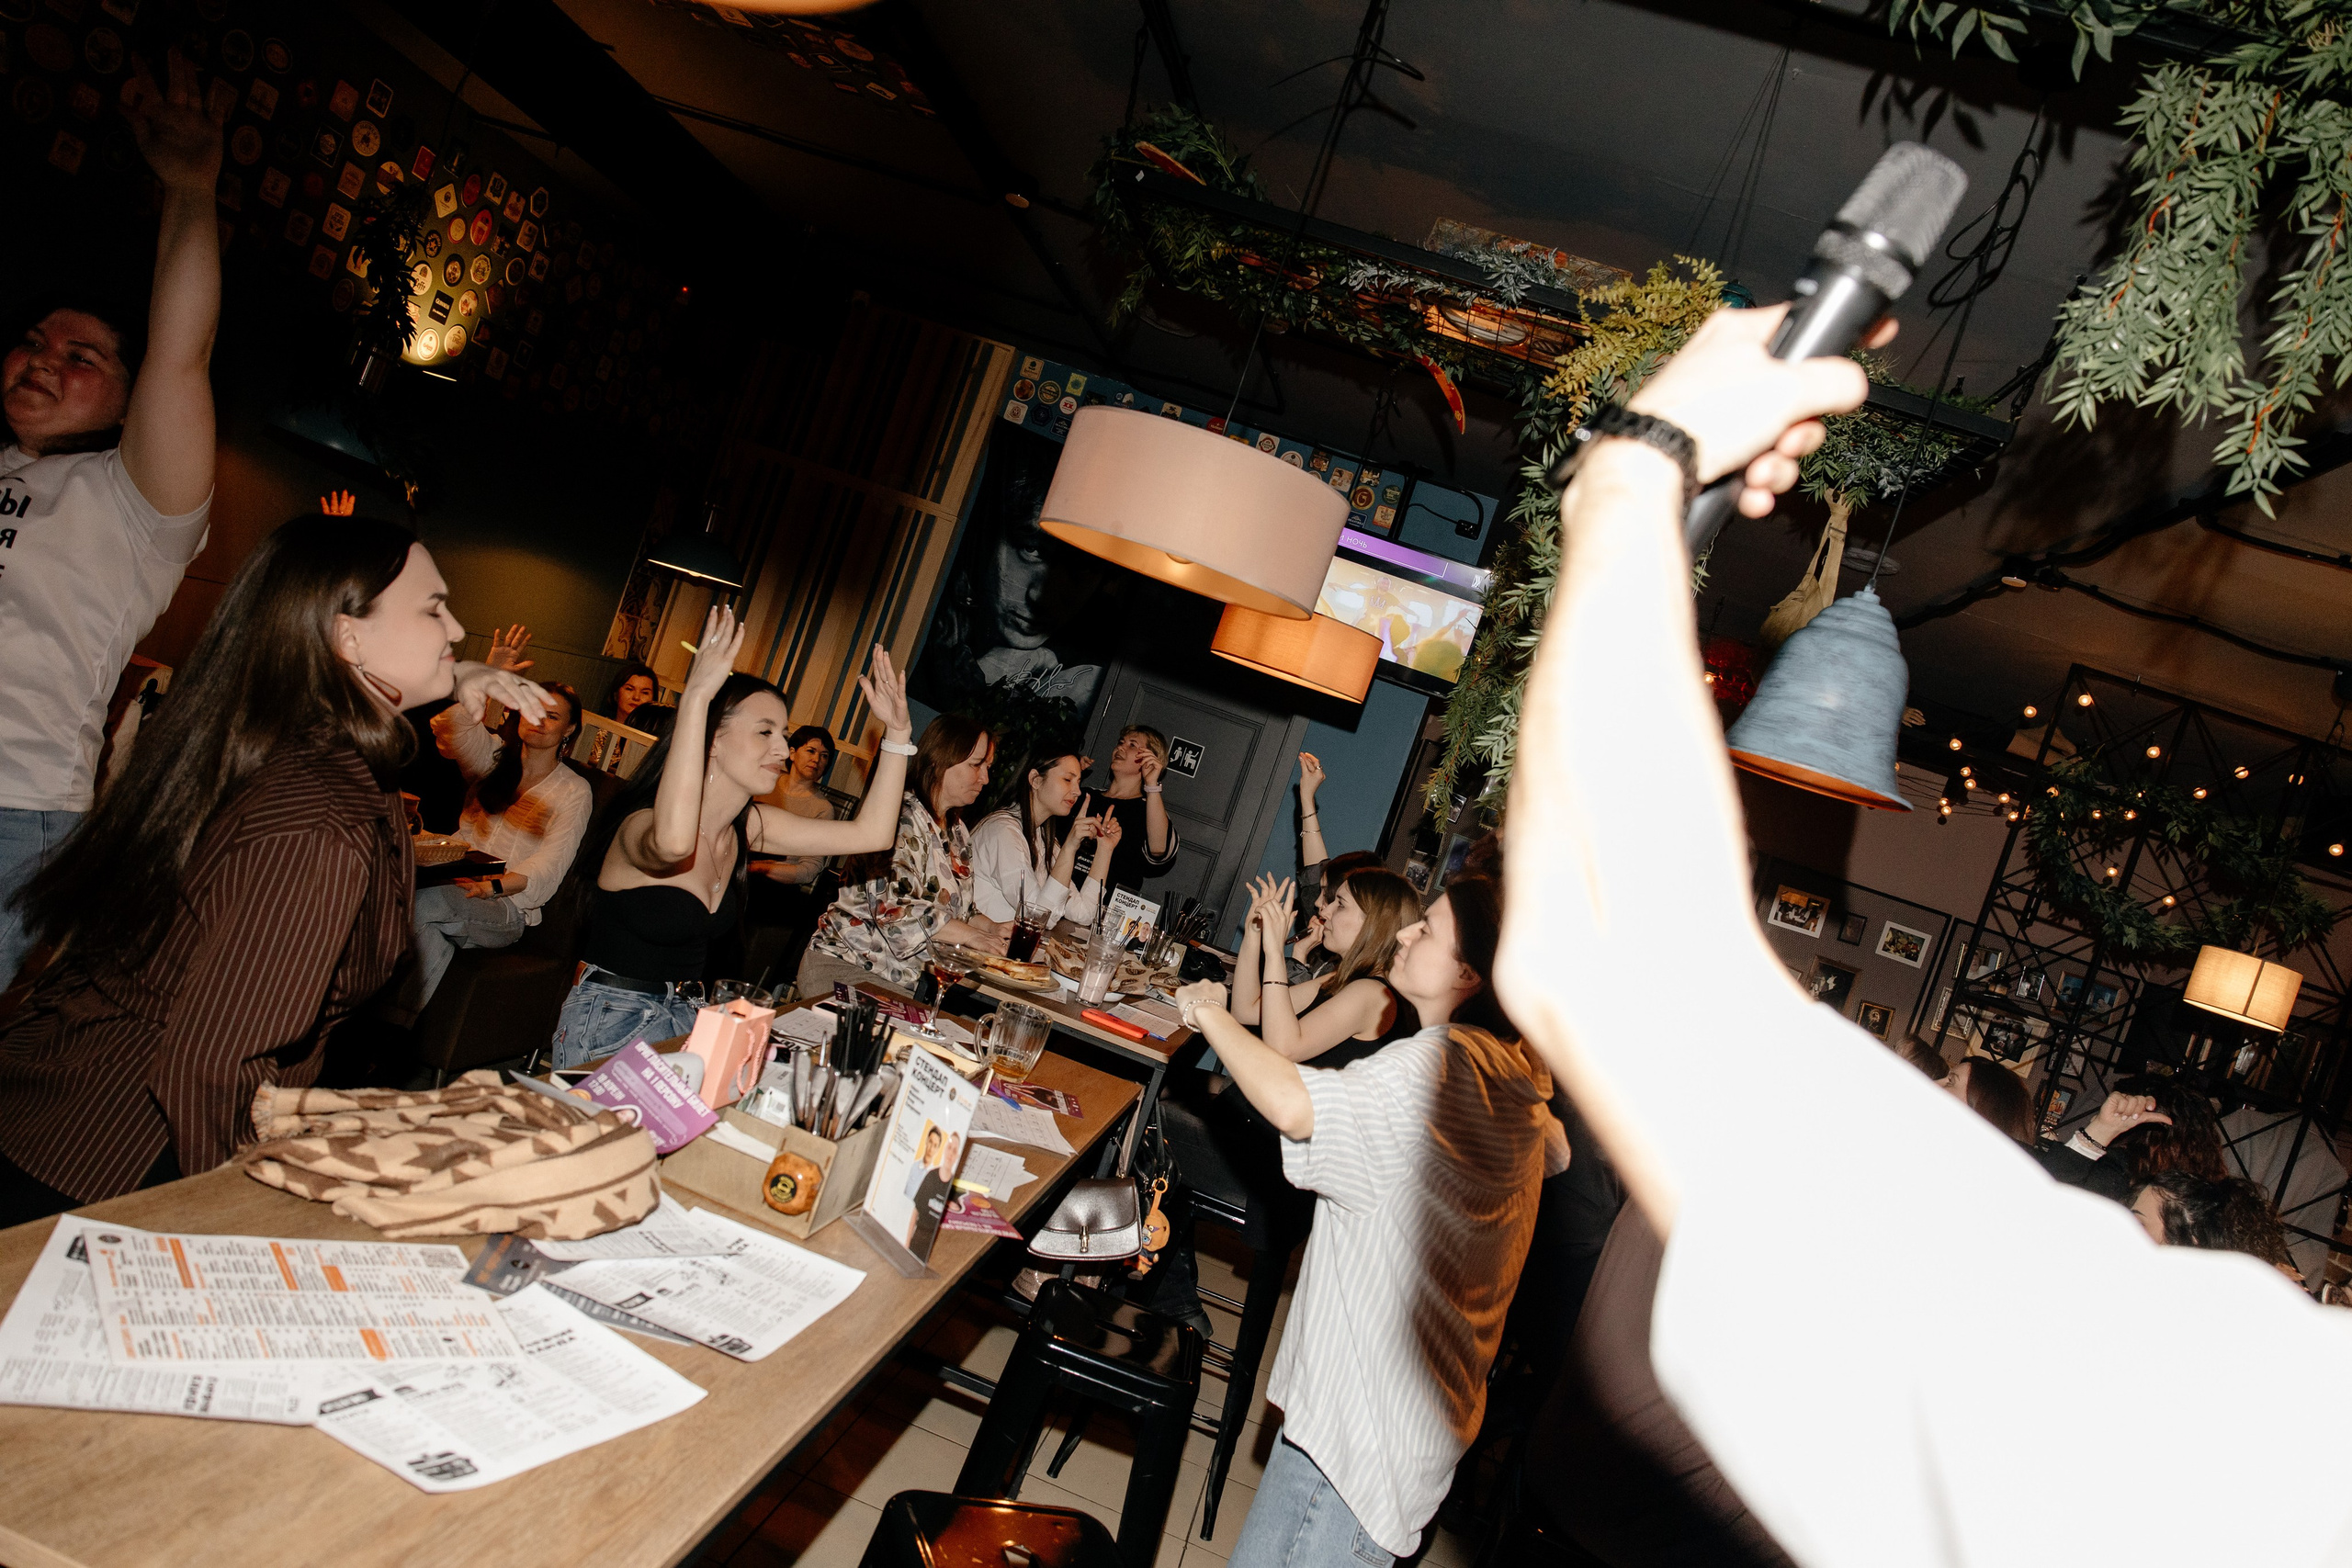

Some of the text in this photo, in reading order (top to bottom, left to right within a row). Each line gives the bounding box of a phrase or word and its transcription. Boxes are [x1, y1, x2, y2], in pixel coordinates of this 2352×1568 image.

[1347, 536, 1368, 548] НОЧЬ
[1114, 897, 1138, 910] КОНЦЕРТ
[1116, 892, 1140, 905] СТЕНДАП
[915, 1056, 948, 1086] СТЕНДАП
[605, 1079, 626, 1101] АПРЕЛЯ
[641, 1066, 655, 1080] НА
[653, 1079, 684, 1109] ПЕРСОНУ
[911, 1068, 944, 1099] КОНЦЕРТ
[686, 1092, 711, 1118] БИЛЕТ
